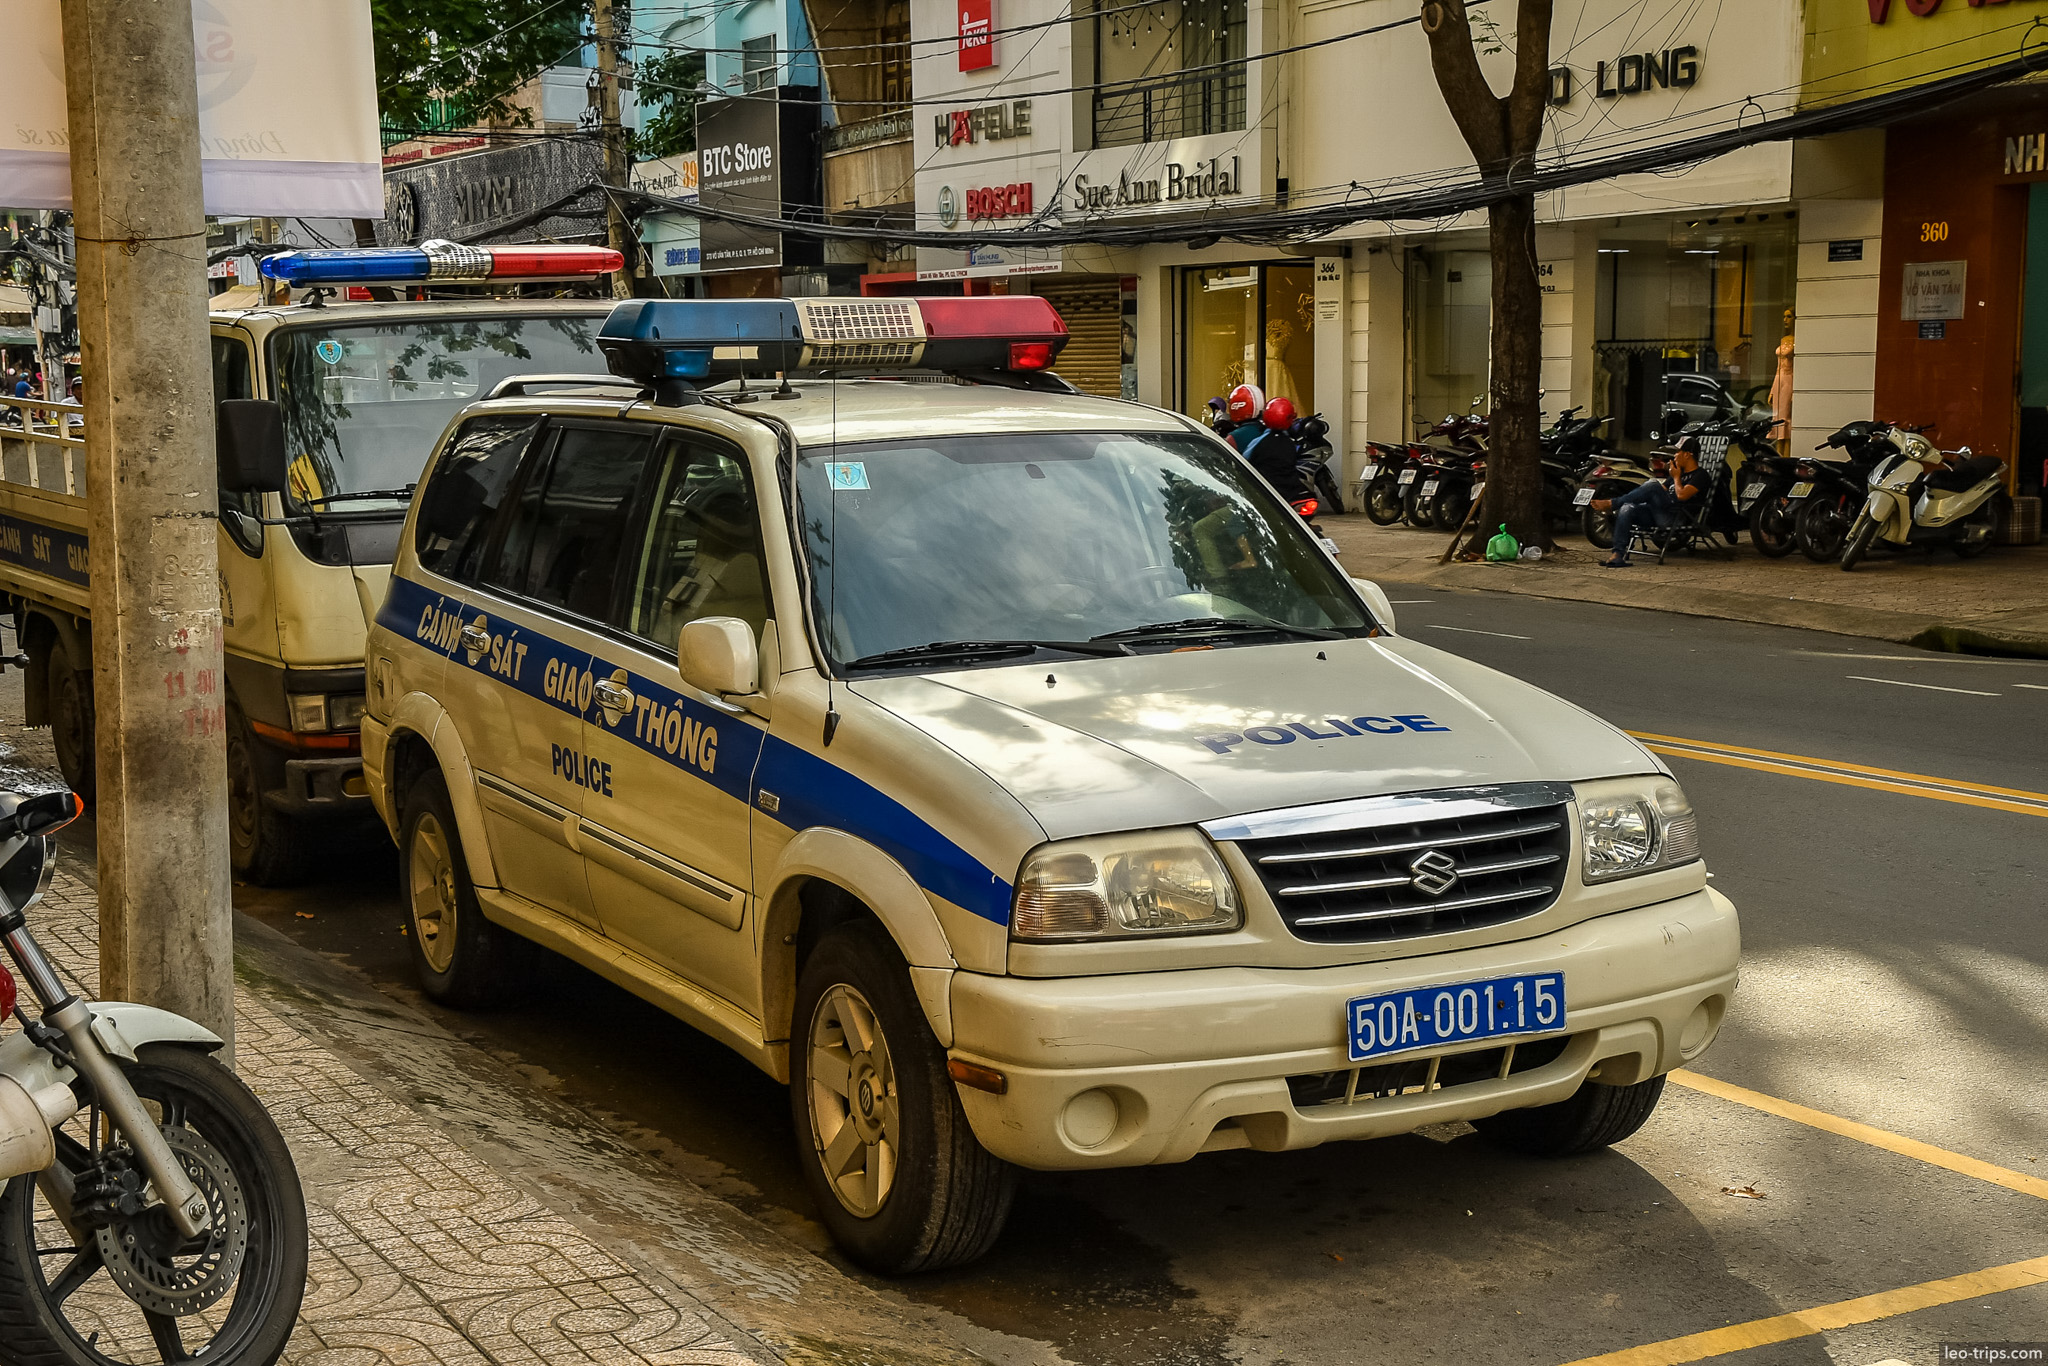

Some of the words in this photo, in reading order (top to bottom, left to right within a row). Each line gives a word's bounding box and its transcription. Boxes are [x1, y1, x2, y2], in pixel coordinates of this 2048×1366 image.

[1596, 46, 1696, 99] LONG
[703, 145, 731, 178] BTC
[735, 142, 772, 173] Store
[2005, 133, 2048, 174] NH
[966, 182, 1032, 220] BOSCH
[1074, 173, 1112, 210] Sue
[1114, 168, 1162, 206] Ann
[1166, 155, 1242, 200] Bridal
[1920, 221, 1949, 242] 360
[1321, 262, 1335, 273] 366
[1932, 269, 1951, 277] KHOA
[489, 630, 528, 682] SÁT
[543, 657, 594, 712] GIAO
[634, 700, 719, 774] THÔNG
[1193, 714, 1453, 755] POLICE
[551, 742, 614, 798] POLICE
[1355, 978, 1558, 1052] 50A-001.15
